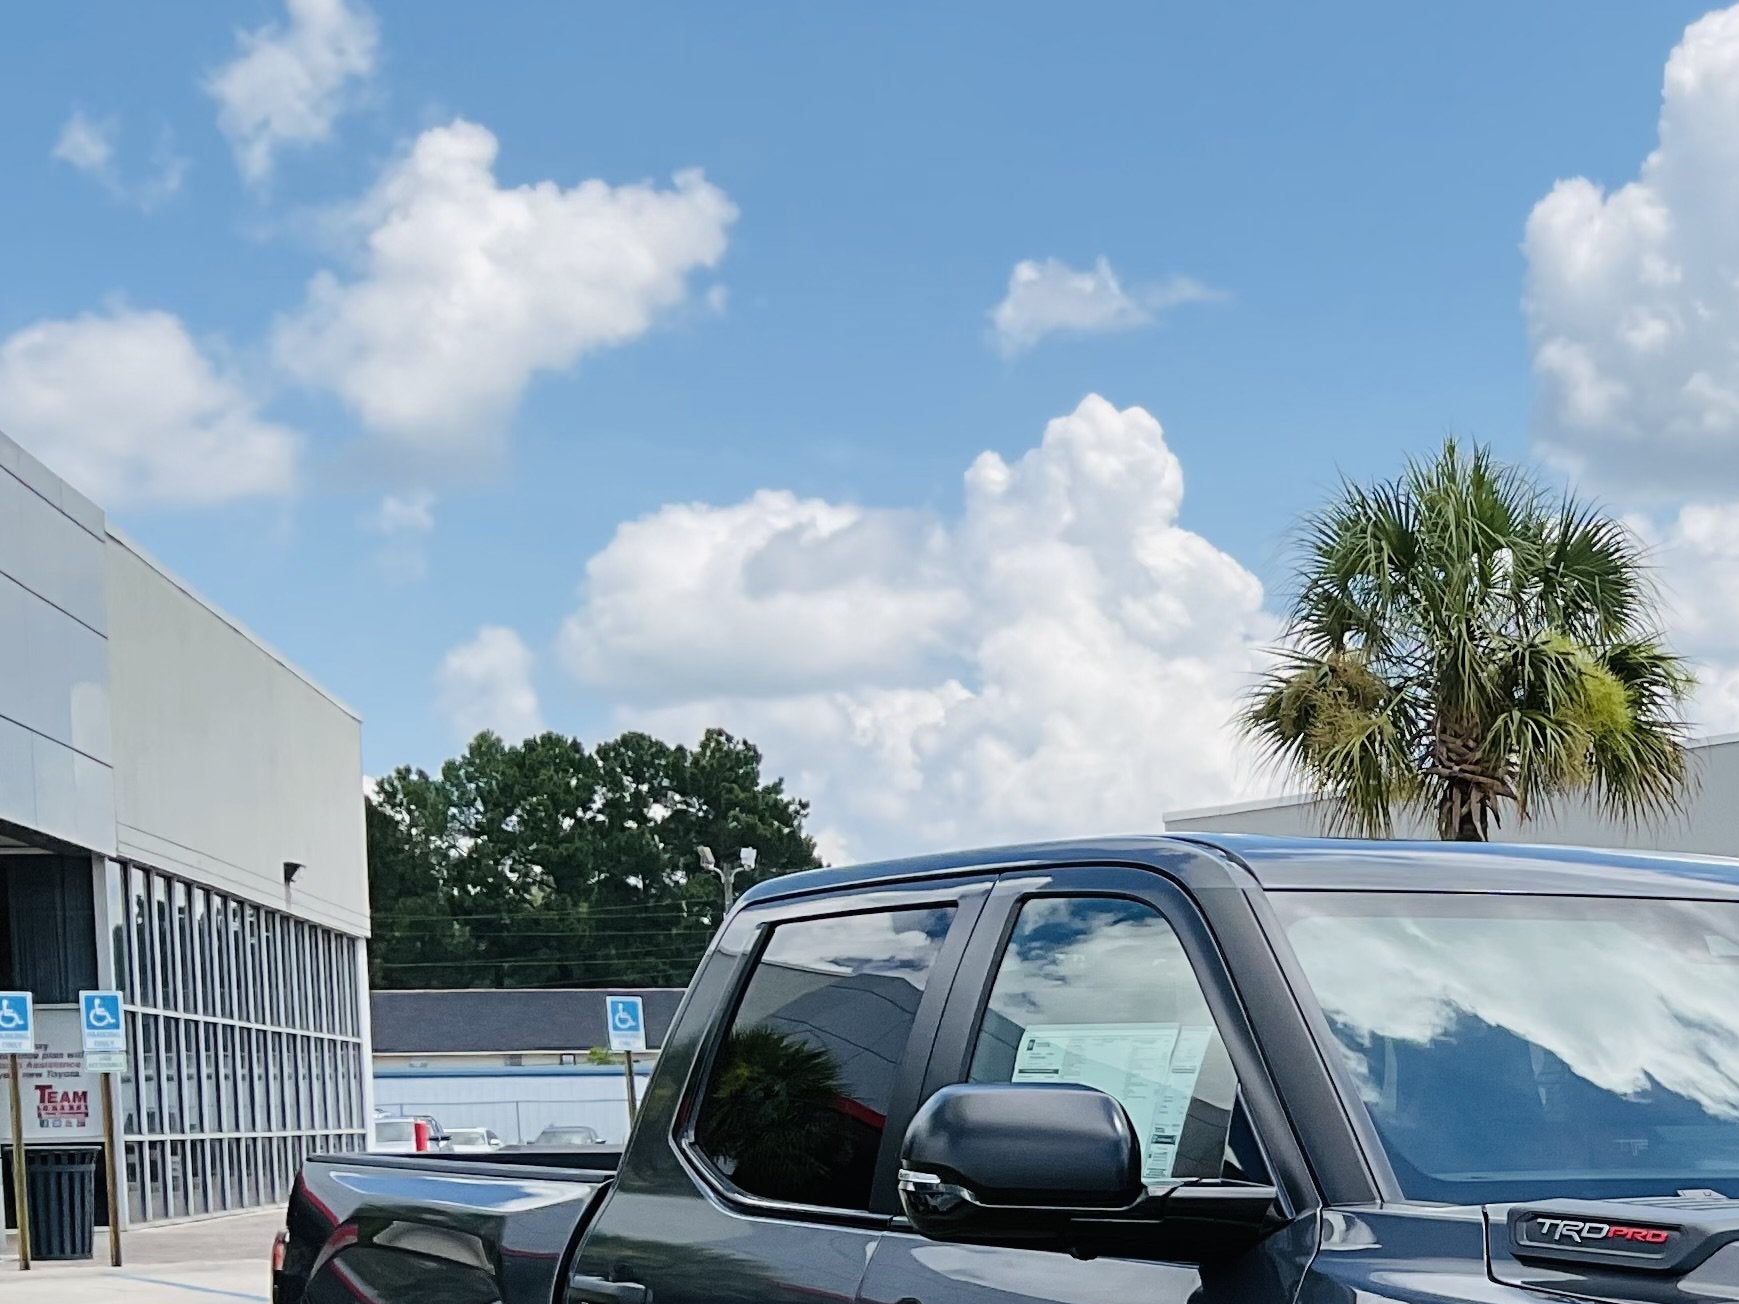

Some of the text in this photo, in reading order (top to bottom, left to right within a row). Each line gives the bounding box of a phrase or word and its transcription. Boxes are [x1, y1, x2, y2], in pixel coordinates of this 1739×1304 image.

[35, 1085, 88, 1104] TEAM
[1537, 1218, 1669, 1244] TRD PRO
